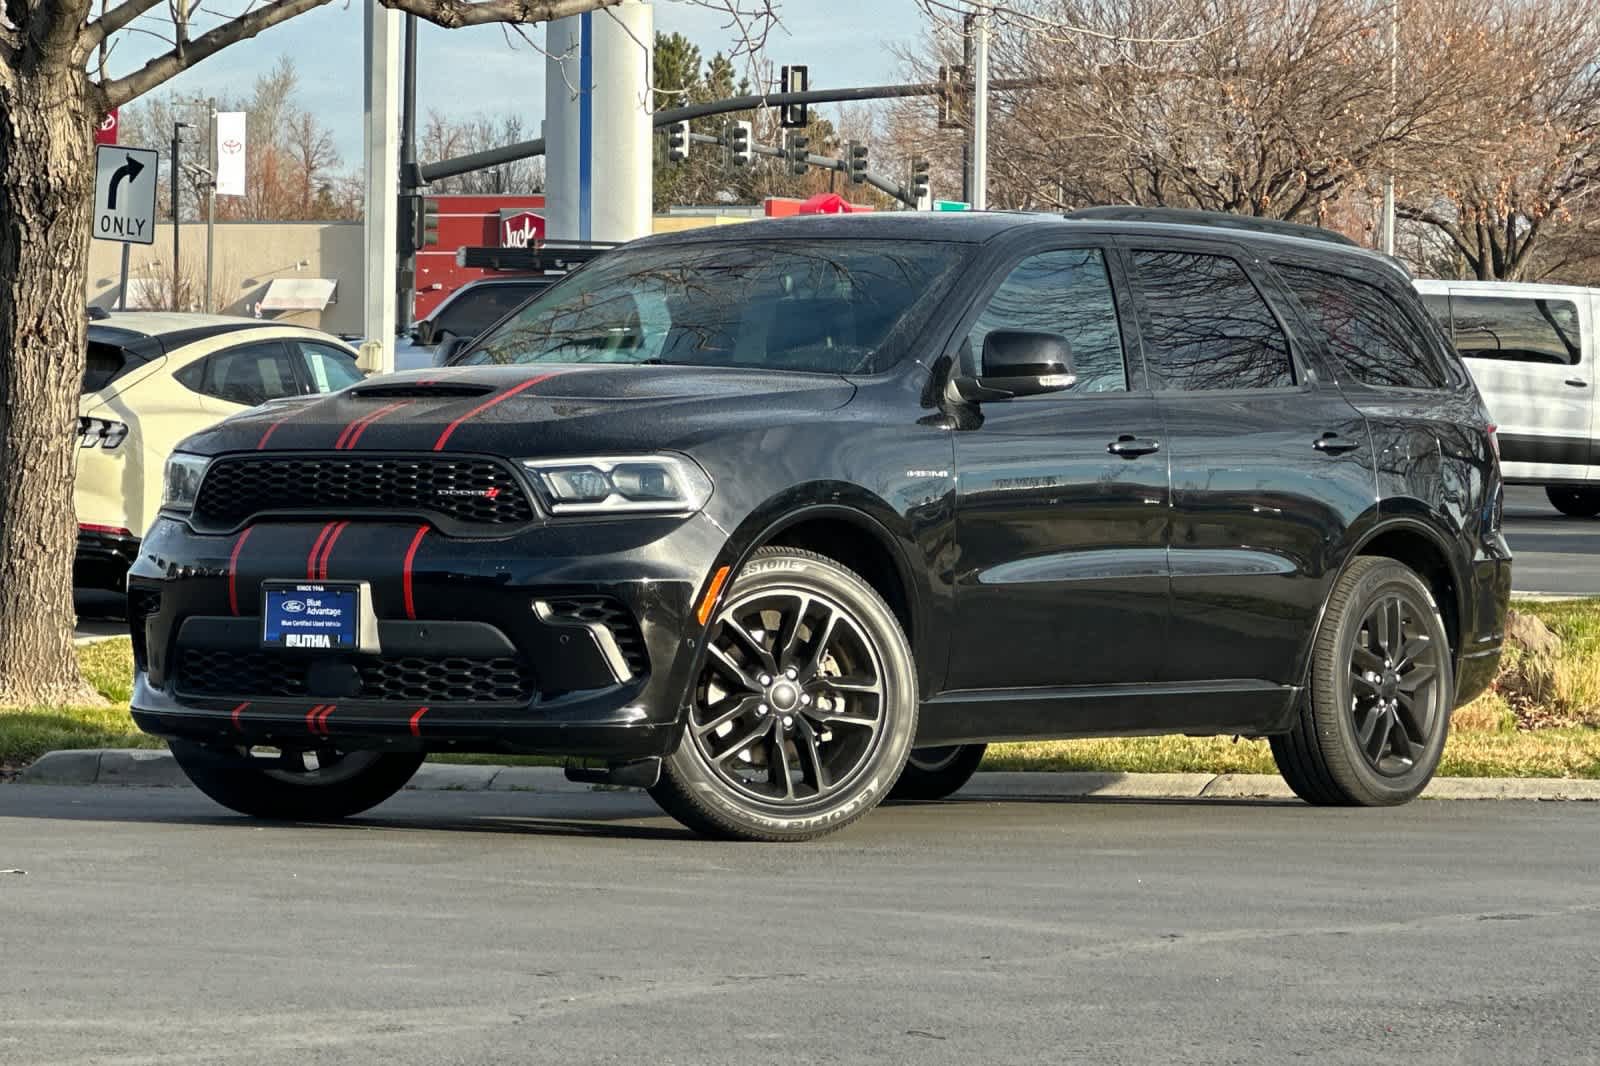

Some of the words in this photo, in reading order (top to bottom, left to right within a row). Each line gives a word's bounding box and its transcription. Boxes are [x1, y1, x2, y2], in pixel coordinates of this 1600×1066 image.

[101, 215, 146, 237] ONLY
[502, 217, 537, 248] Jack
[306, 598, 322, 607] Blue
[306, 607, 341, 617] Advantage
[297, 634, 331, 648] LITHIA
